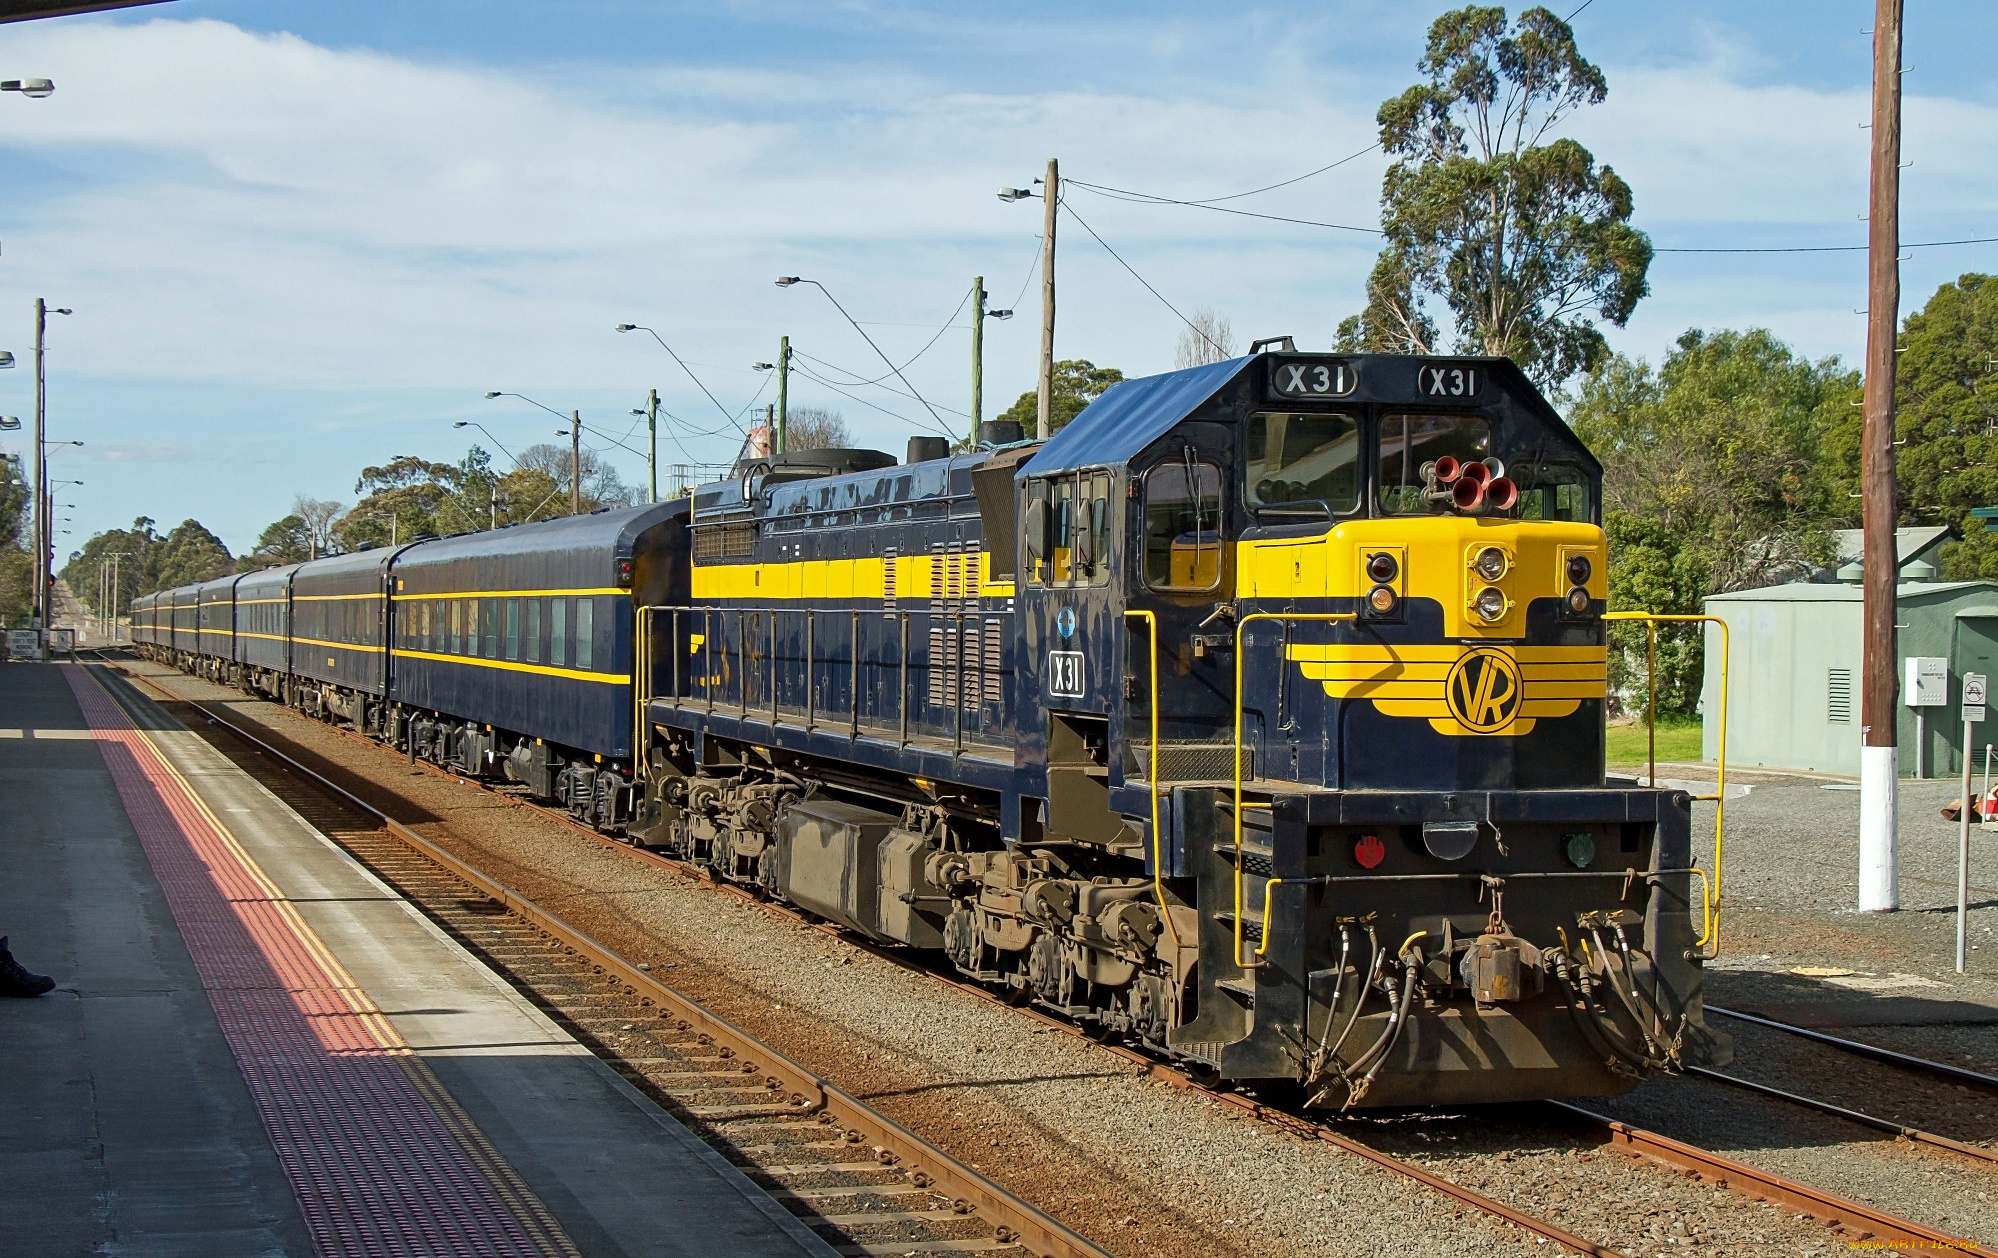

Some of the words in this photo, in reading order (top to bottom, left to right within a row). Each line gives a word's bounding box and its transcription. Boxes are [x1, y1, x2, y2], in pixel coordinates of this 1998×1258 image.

[1285, 365, 1344, 393] X31
[1429, 368, 1475, 396] X31
[1054, 656, 1079, 692] X31
[1458, 655, 1516, 725] VR
